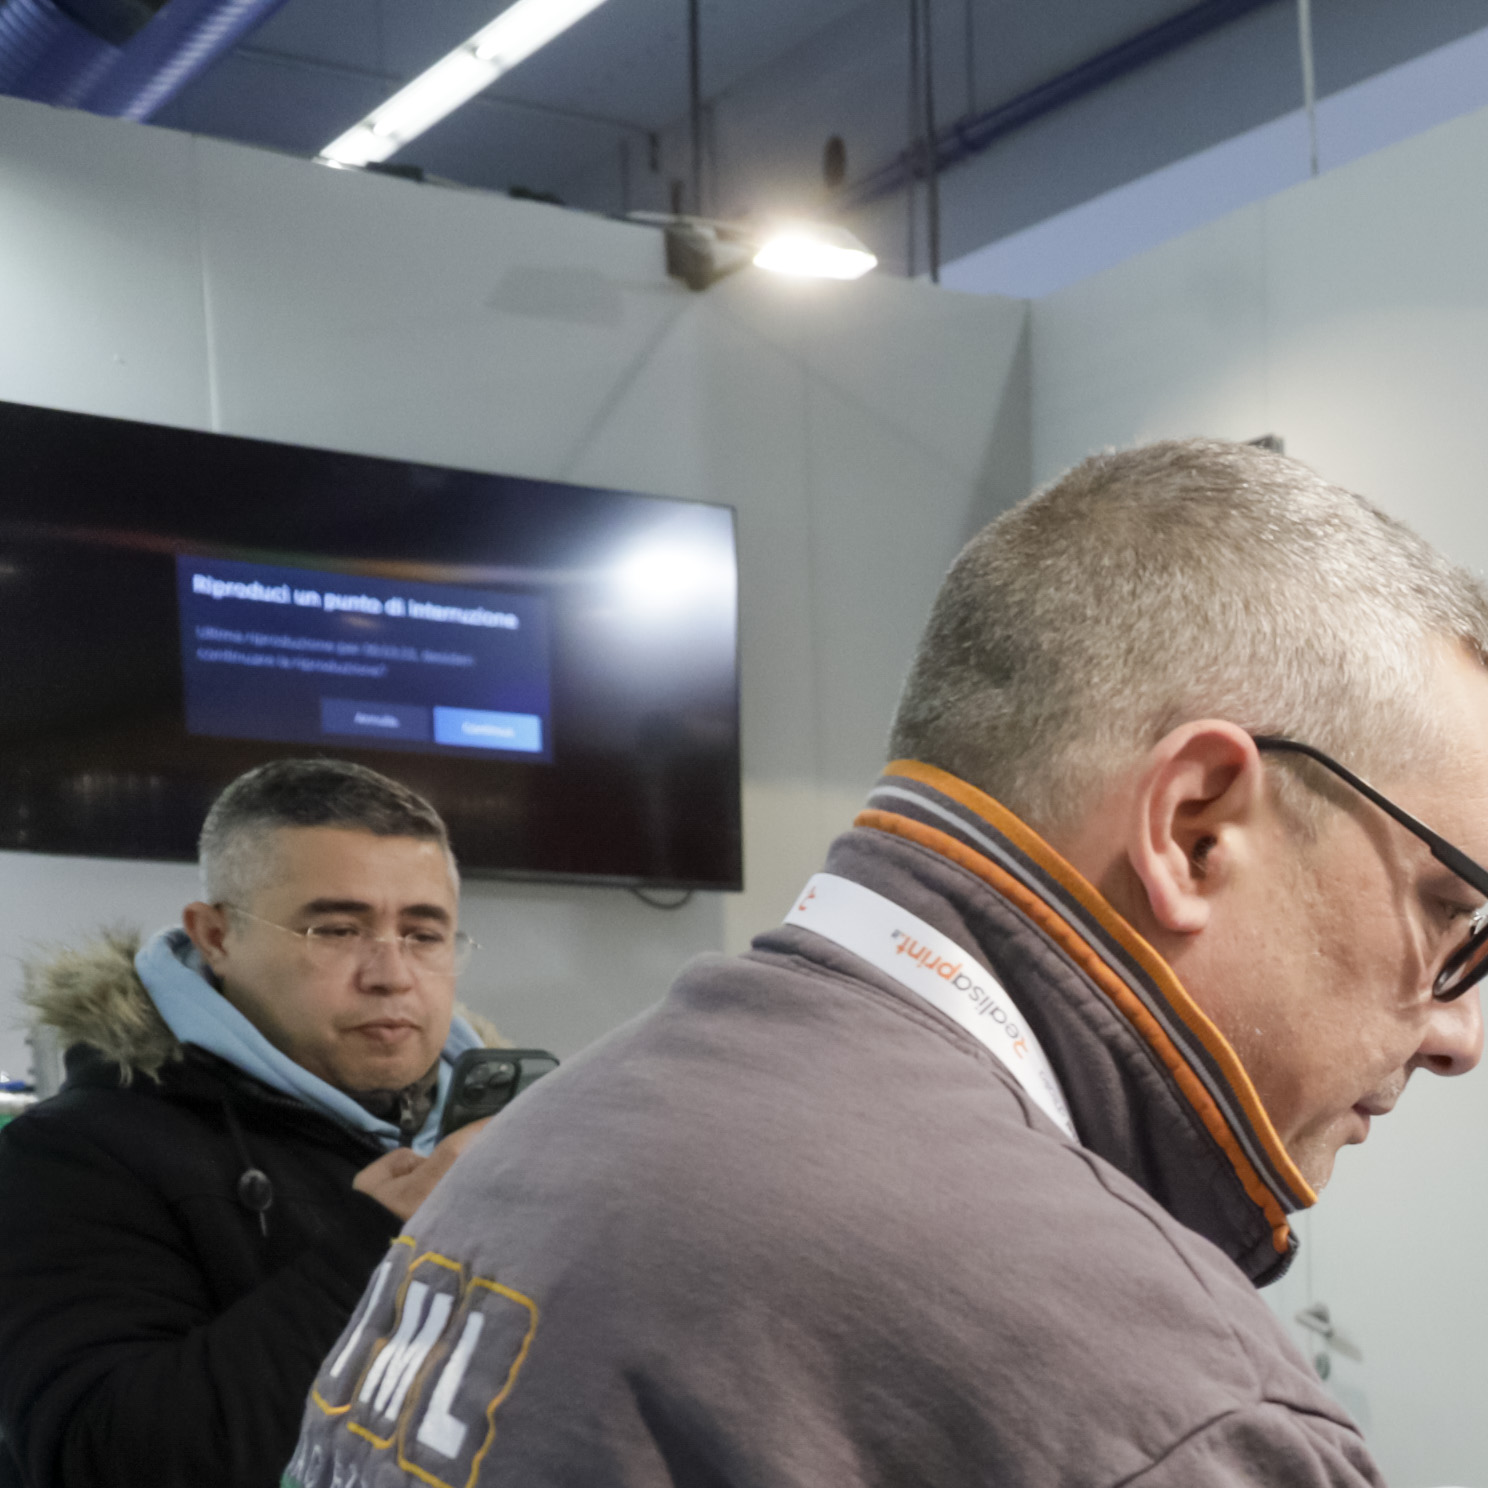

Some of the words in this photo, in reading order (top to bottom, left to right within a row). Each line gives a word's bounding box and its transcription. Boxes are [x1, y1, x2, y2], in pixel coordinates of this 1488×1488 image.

[192, 573, 292, 604] Riproduci
[294, 589, 322, 608] un
[323, 591, 384, 615] punto
[384, 596, 406, 617] di
[407, 598, 519, 630] interruzione
[330, 1261, 485, 1459] IML
